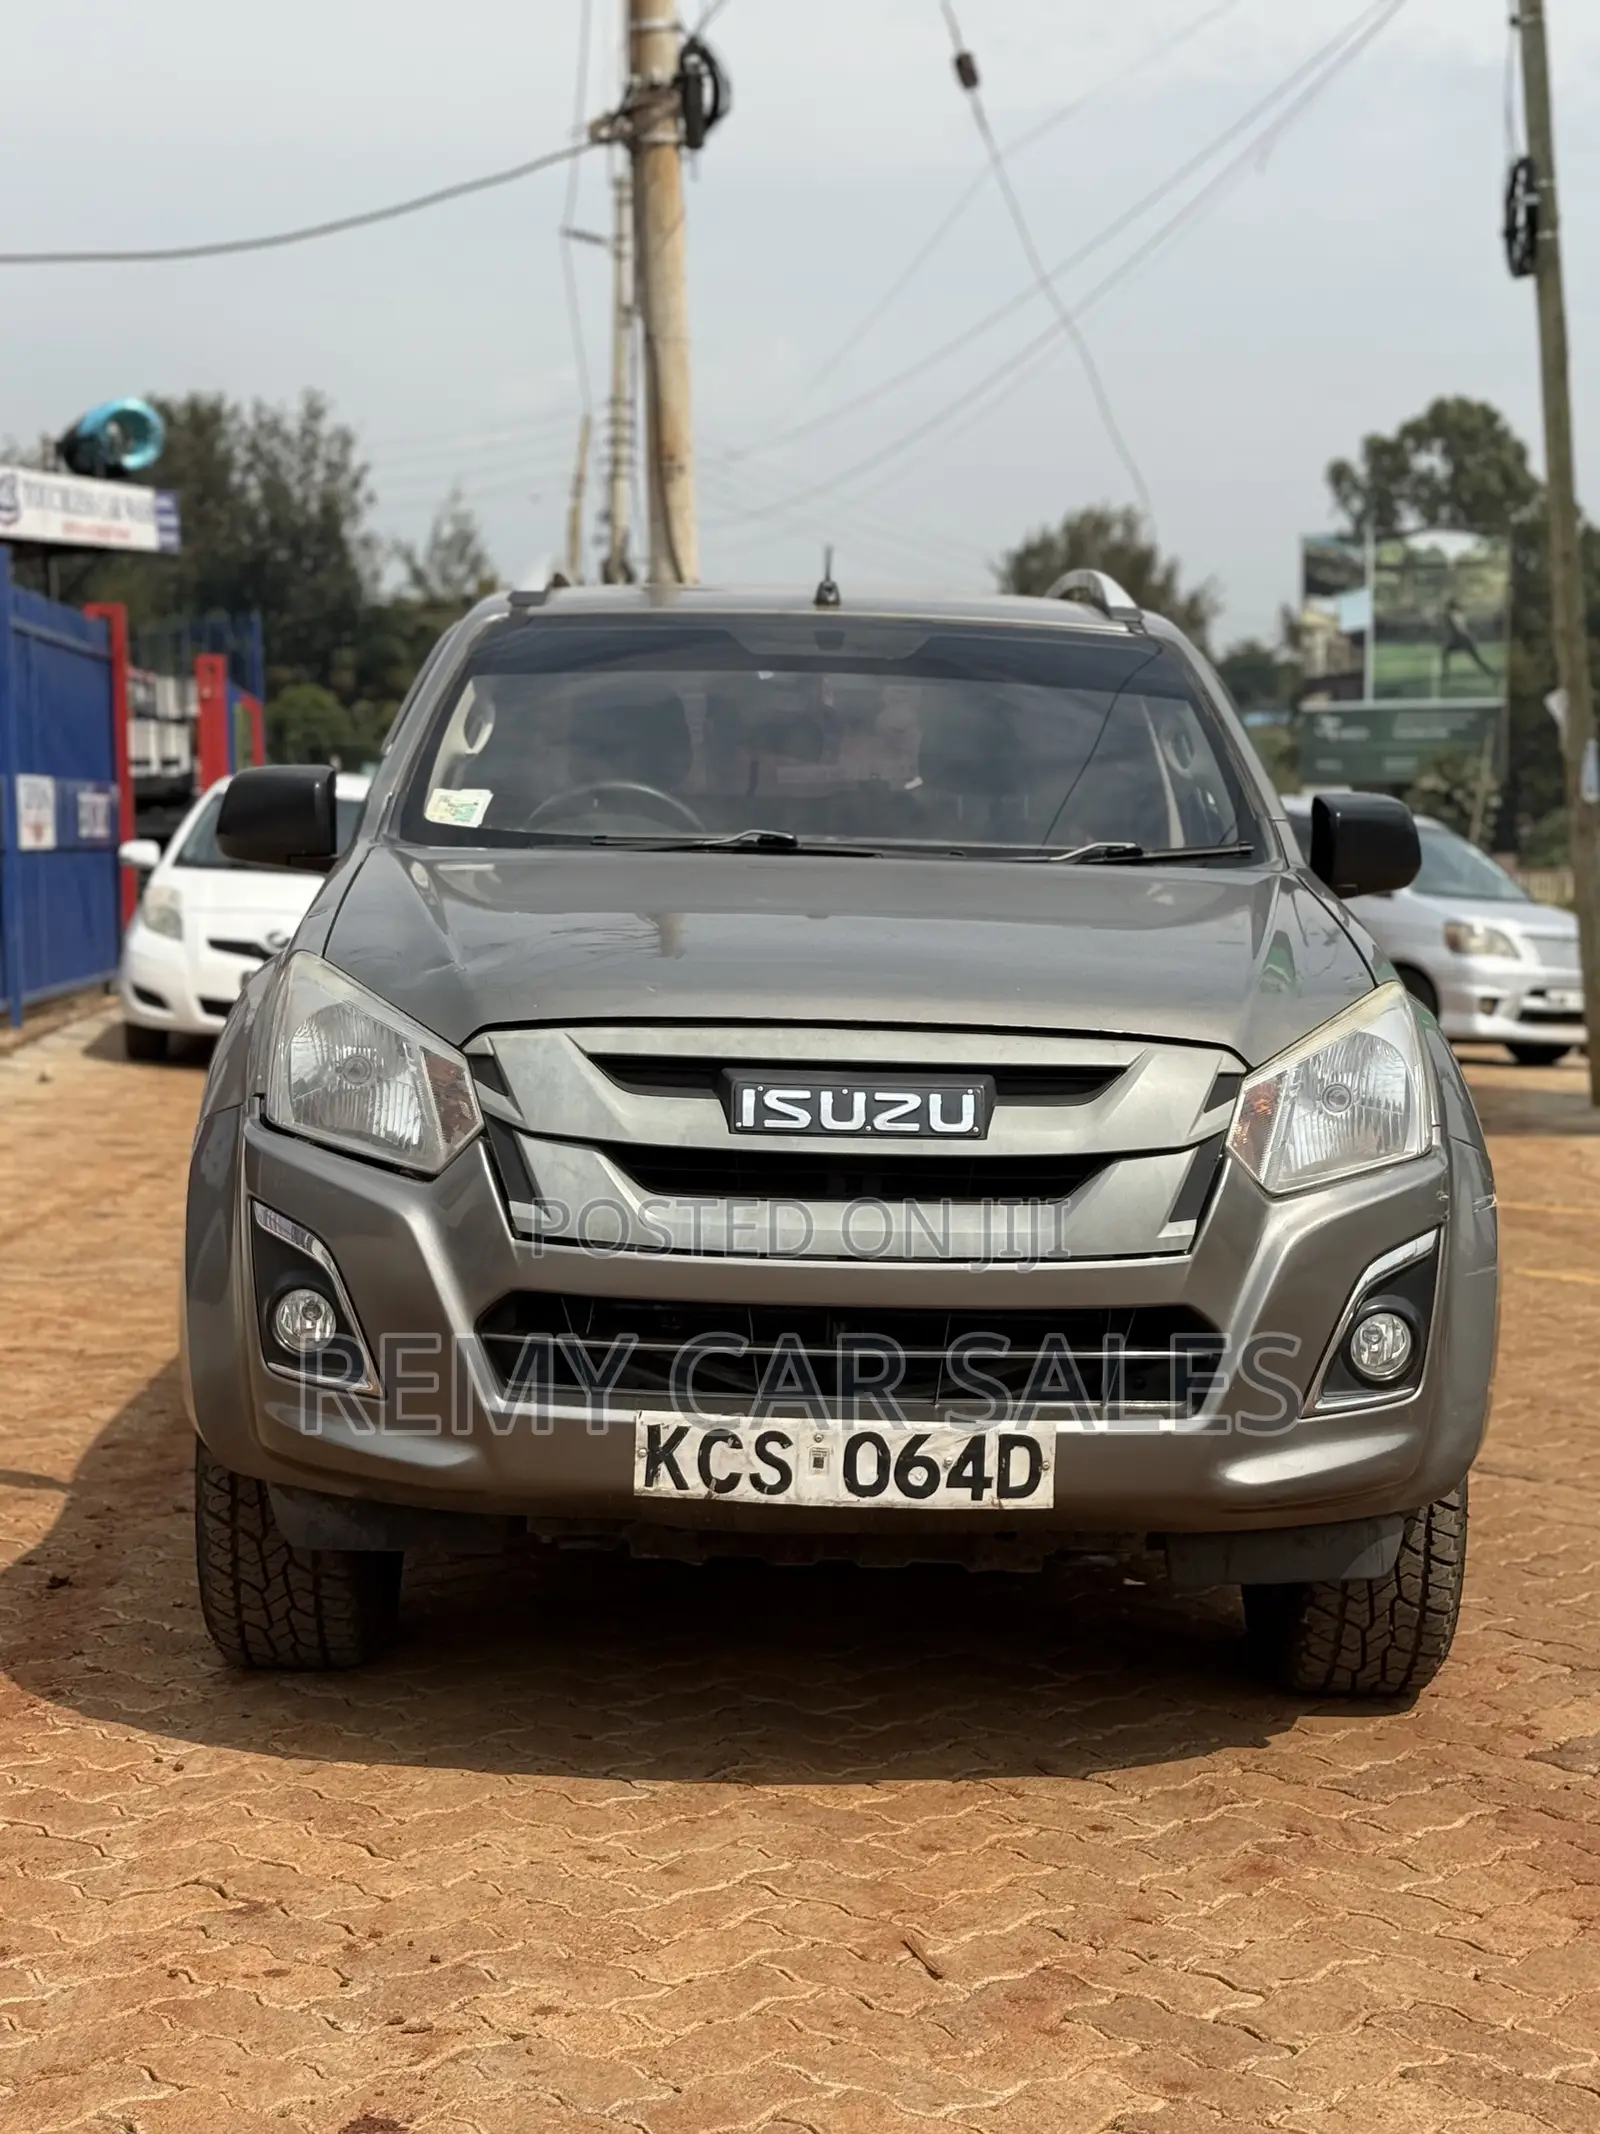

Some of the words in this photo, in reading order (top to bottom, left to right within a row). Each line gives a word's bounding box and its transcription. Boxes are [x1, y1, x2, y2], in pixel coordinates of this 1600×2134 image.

[742, 1089, 975, 1133] ISUZU
[645, 1424, 793, 1495] KCS
[843, 1430, 1044, 1501] 064D
